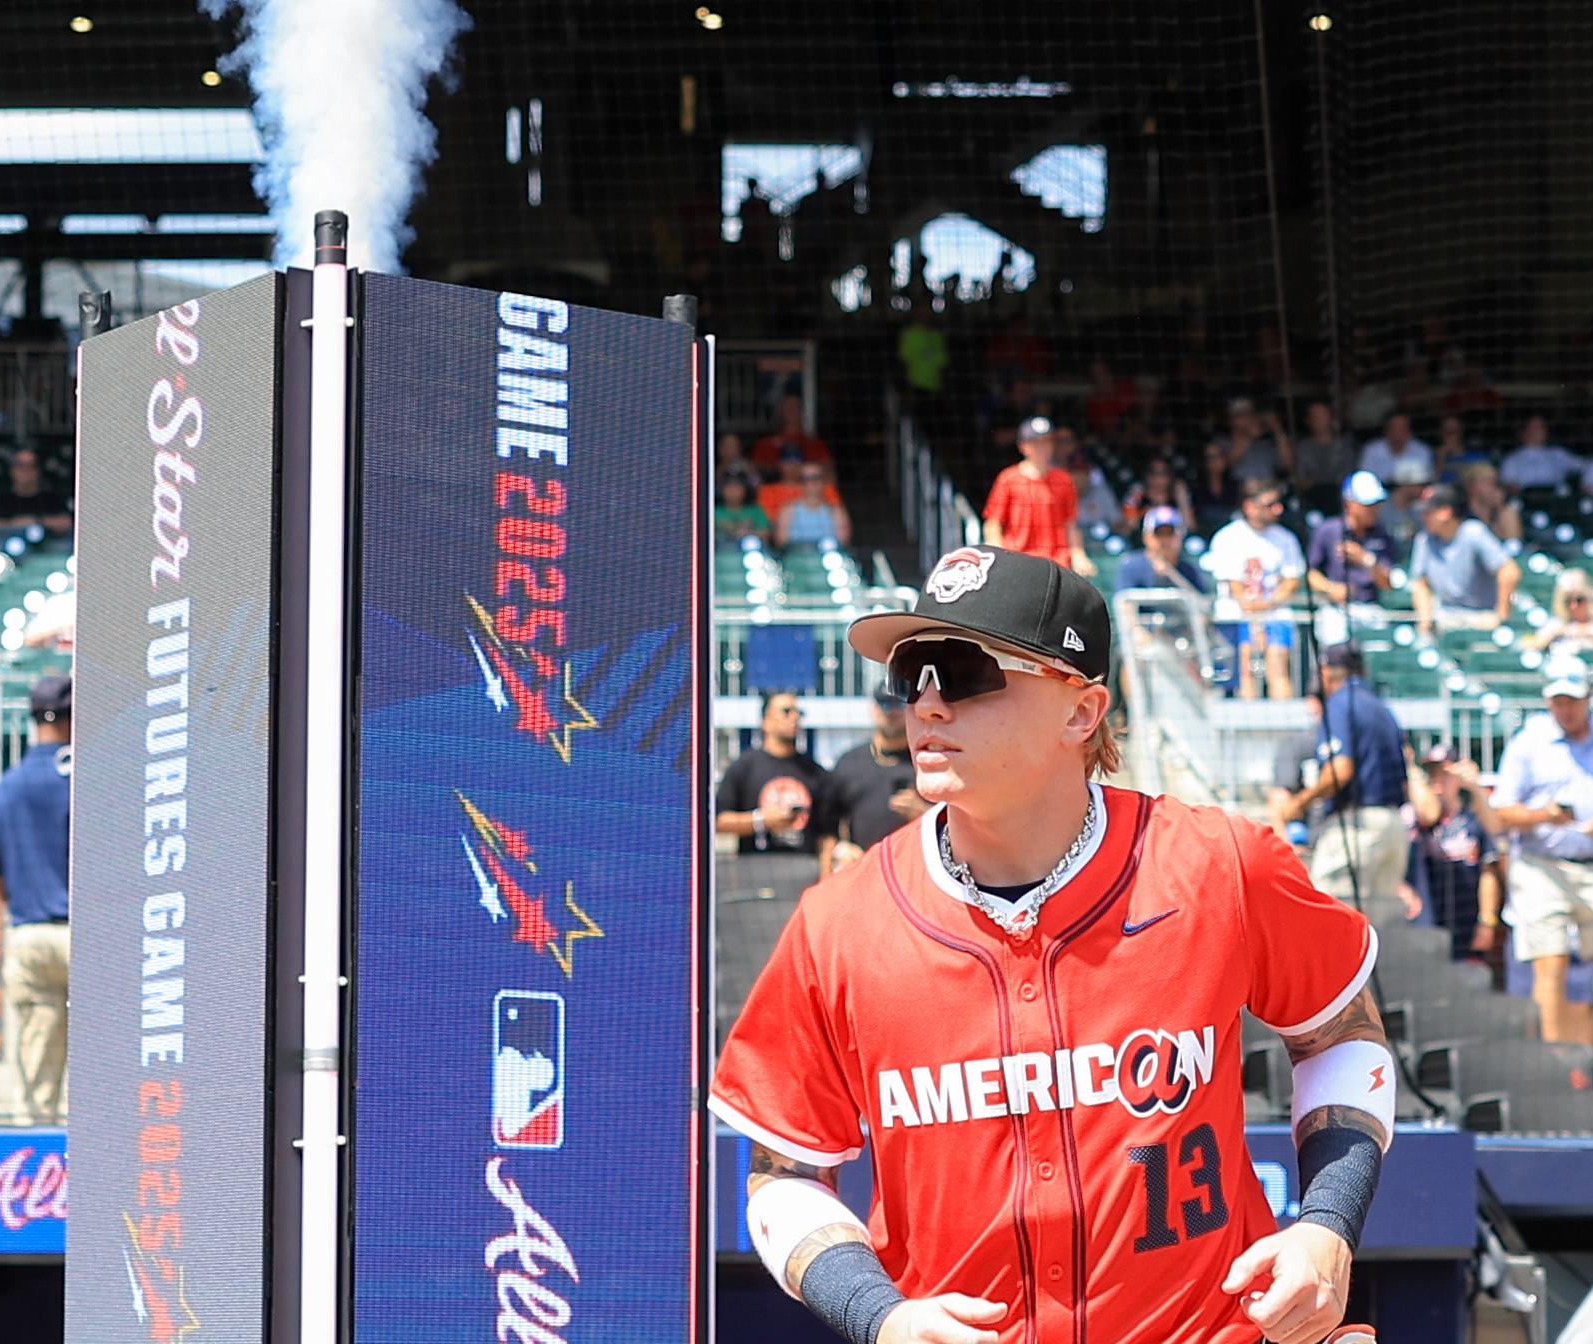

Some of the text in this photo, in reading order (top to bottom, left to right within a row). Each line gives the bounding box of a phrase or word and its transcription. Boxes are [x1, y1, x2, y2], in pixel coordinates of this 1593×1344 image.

[494, 290, 570, 647] GAME 2025
[142, 597, 191, 877] FUTURES
[139, 891, 187, 1067] GAME
[136, 1080, 184, 1251] 2025
[1127, 1122, 1230, 1254] 13
